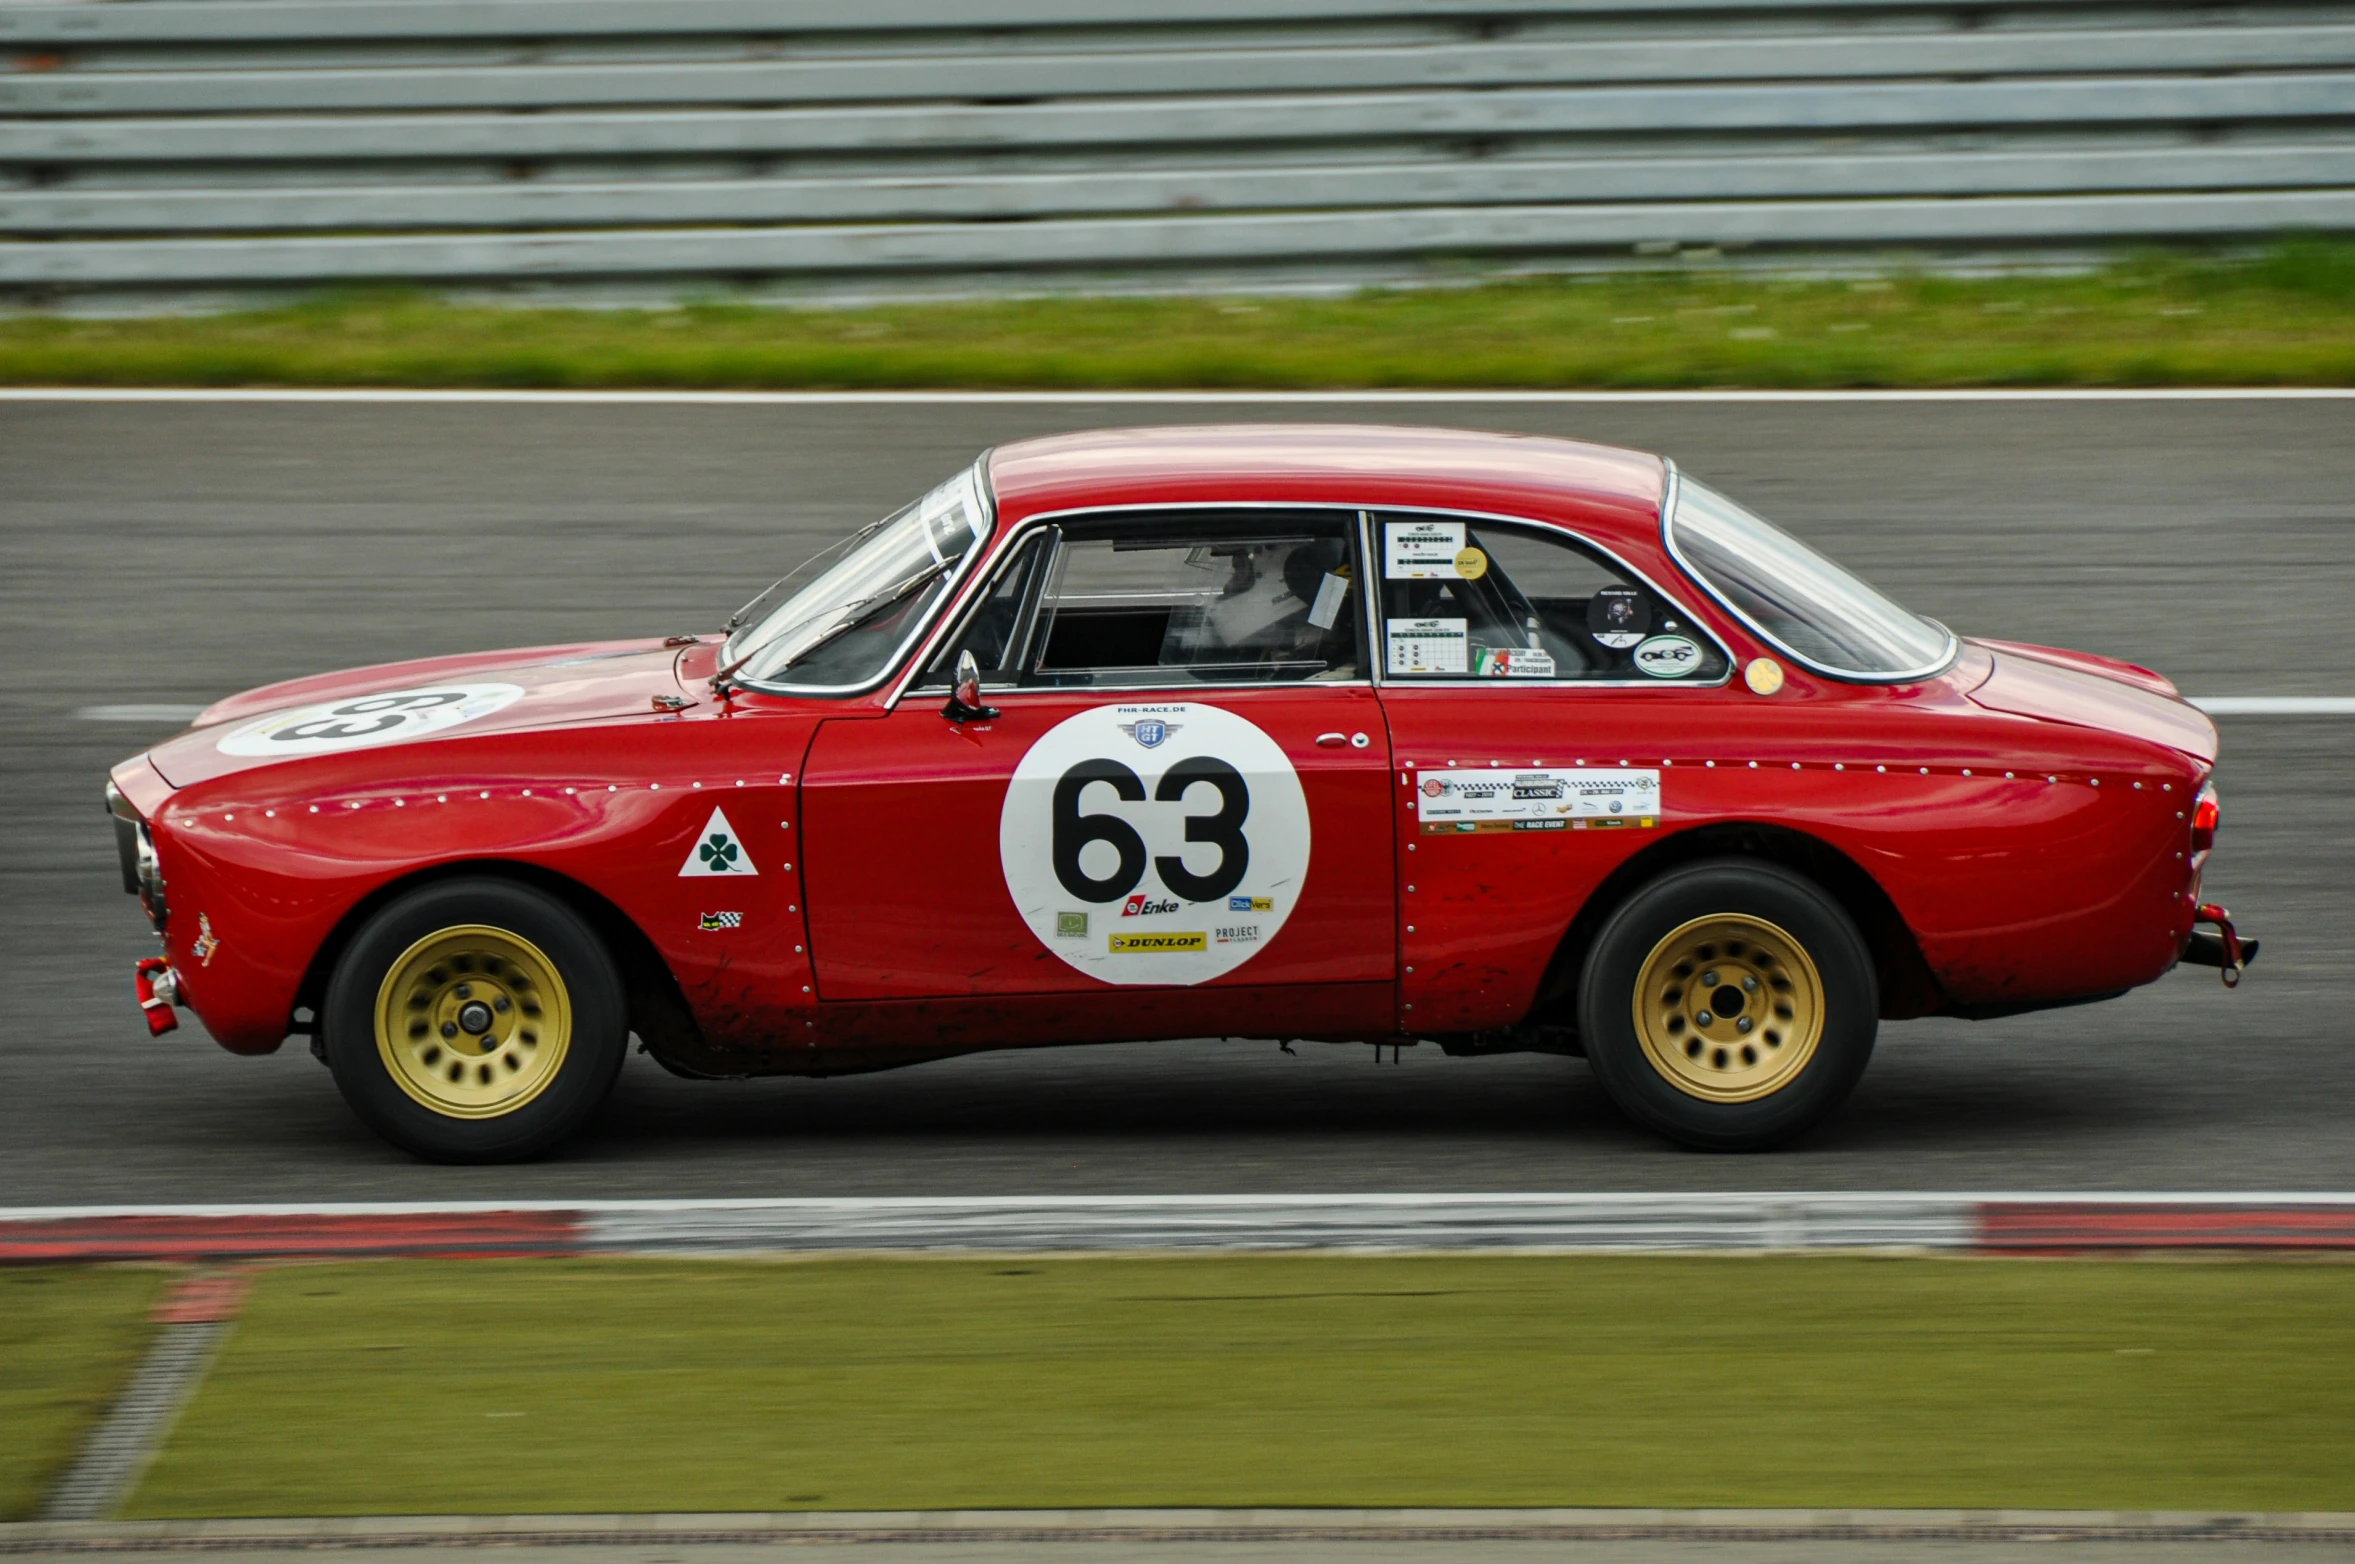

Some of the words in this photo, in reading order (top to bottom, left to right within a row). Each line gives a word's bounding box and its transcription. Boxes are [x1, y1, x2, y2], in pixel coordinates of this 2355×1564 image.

[1507, 664, 1552, 675] Participant
[1117, 706, 1187, 714] FHR-RACE.DE
[270, 692, 468, 741] 63
[1513, 788, 1556, 798] CLASSIC
[1052, 755, 1250, 904] 63
[1545, 820, 1566, 828] EVENT
[1141, 899, 1180, 916] Enke
[1216, 926, 1259, 938] PROJECT
[1128, 937, 1202, 948] DUNLOP
